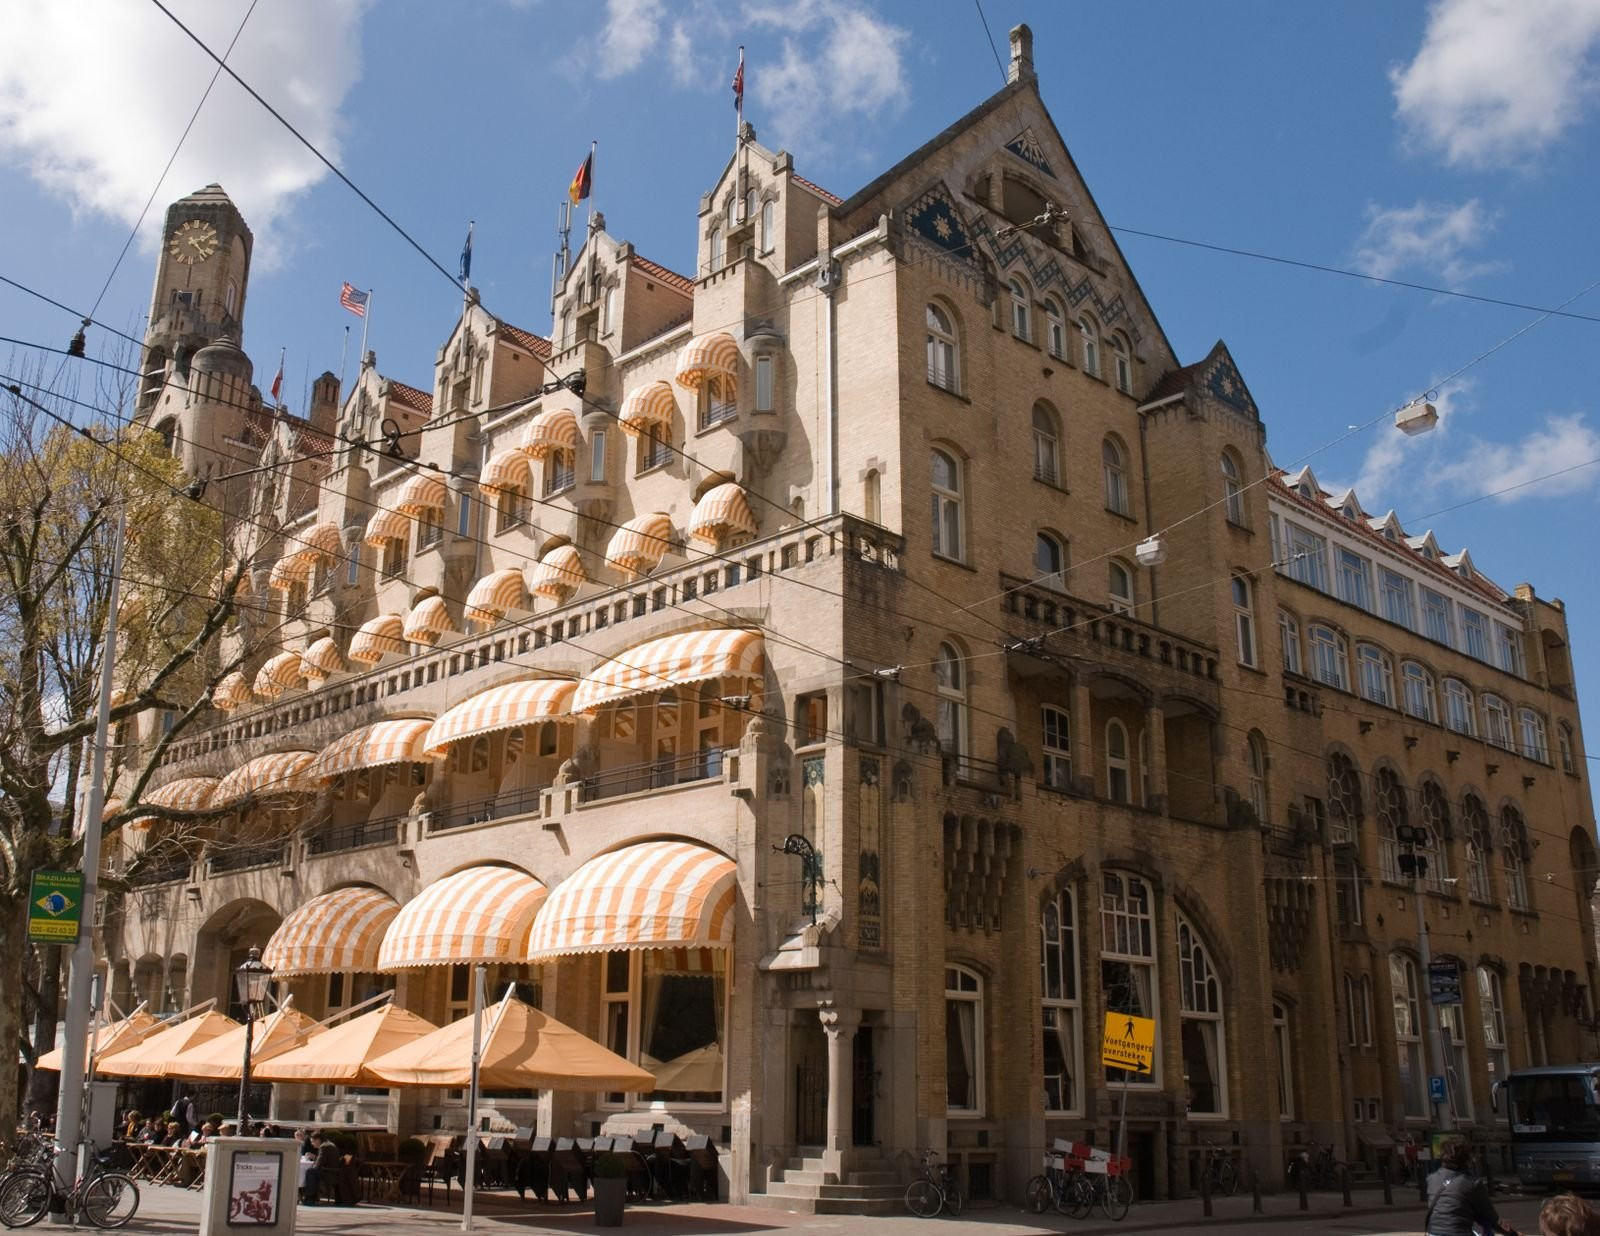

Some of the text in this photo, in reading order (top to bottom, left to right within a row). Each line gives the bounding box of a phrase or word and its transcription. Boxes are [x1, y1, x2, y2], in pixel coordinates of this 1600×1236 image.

[1104, 1036, 1153, 1053] Voetgangers
[1103, 1047, 1146, 1061] oversteken
[1432, 1078, 1441, 1091] P
